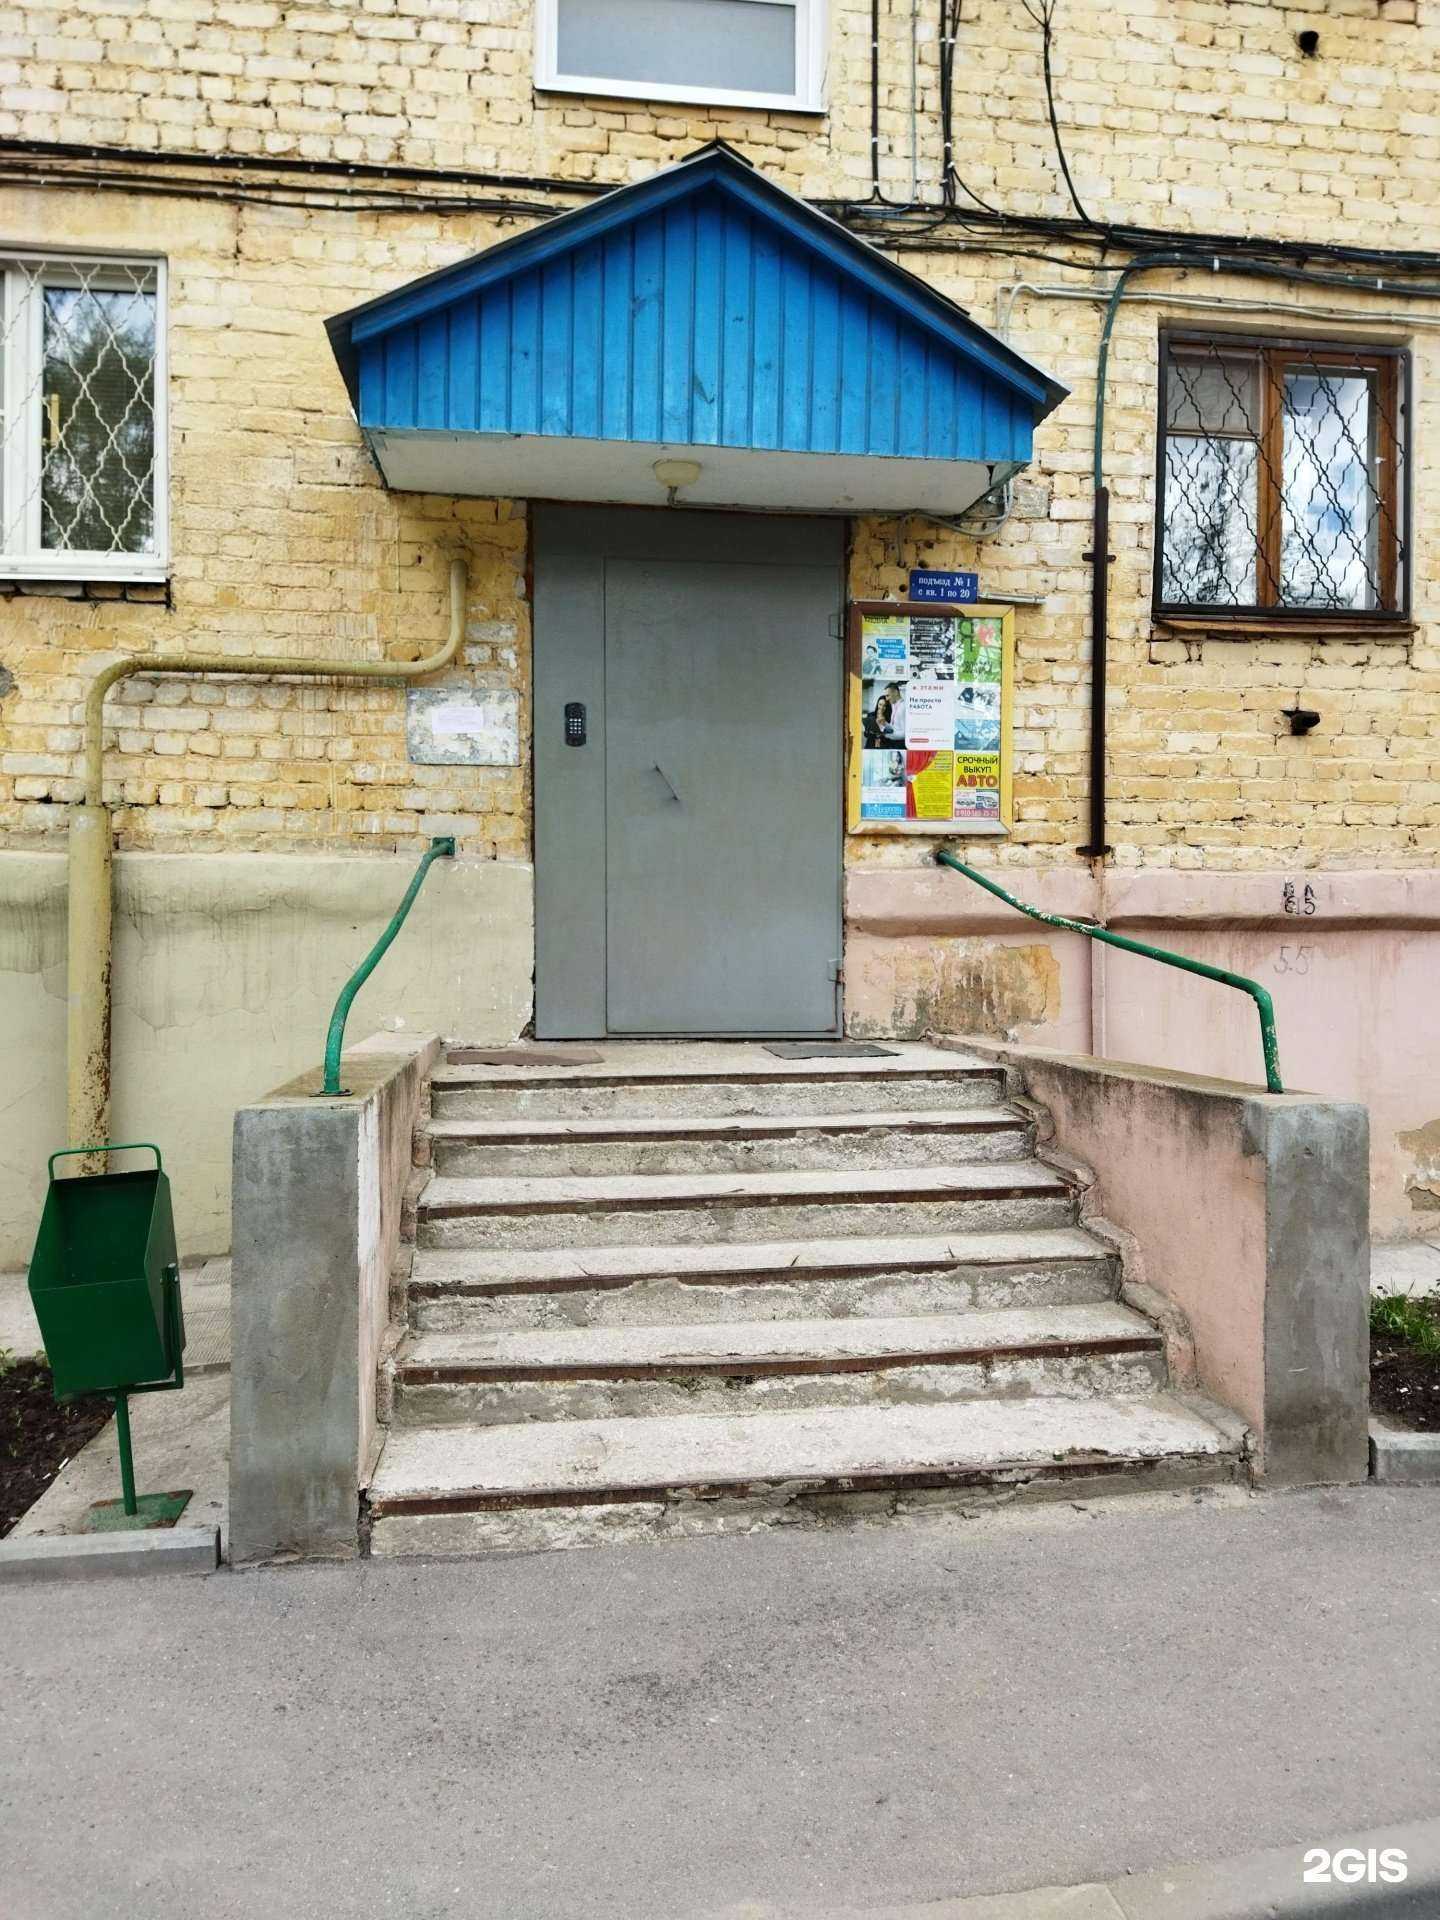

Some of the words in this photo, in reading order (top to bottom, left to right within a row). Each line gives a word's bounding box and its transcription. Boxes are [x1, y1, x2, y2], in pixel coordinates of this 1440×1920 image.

[918, 577, 951, 586] подъезд
[954, 577, 964, 586] №
[960, 589, 970, 598] 20
[957, 755, 998, 764] СРОЧНЫЙ
[956, 774, 998, 787] АВТО
